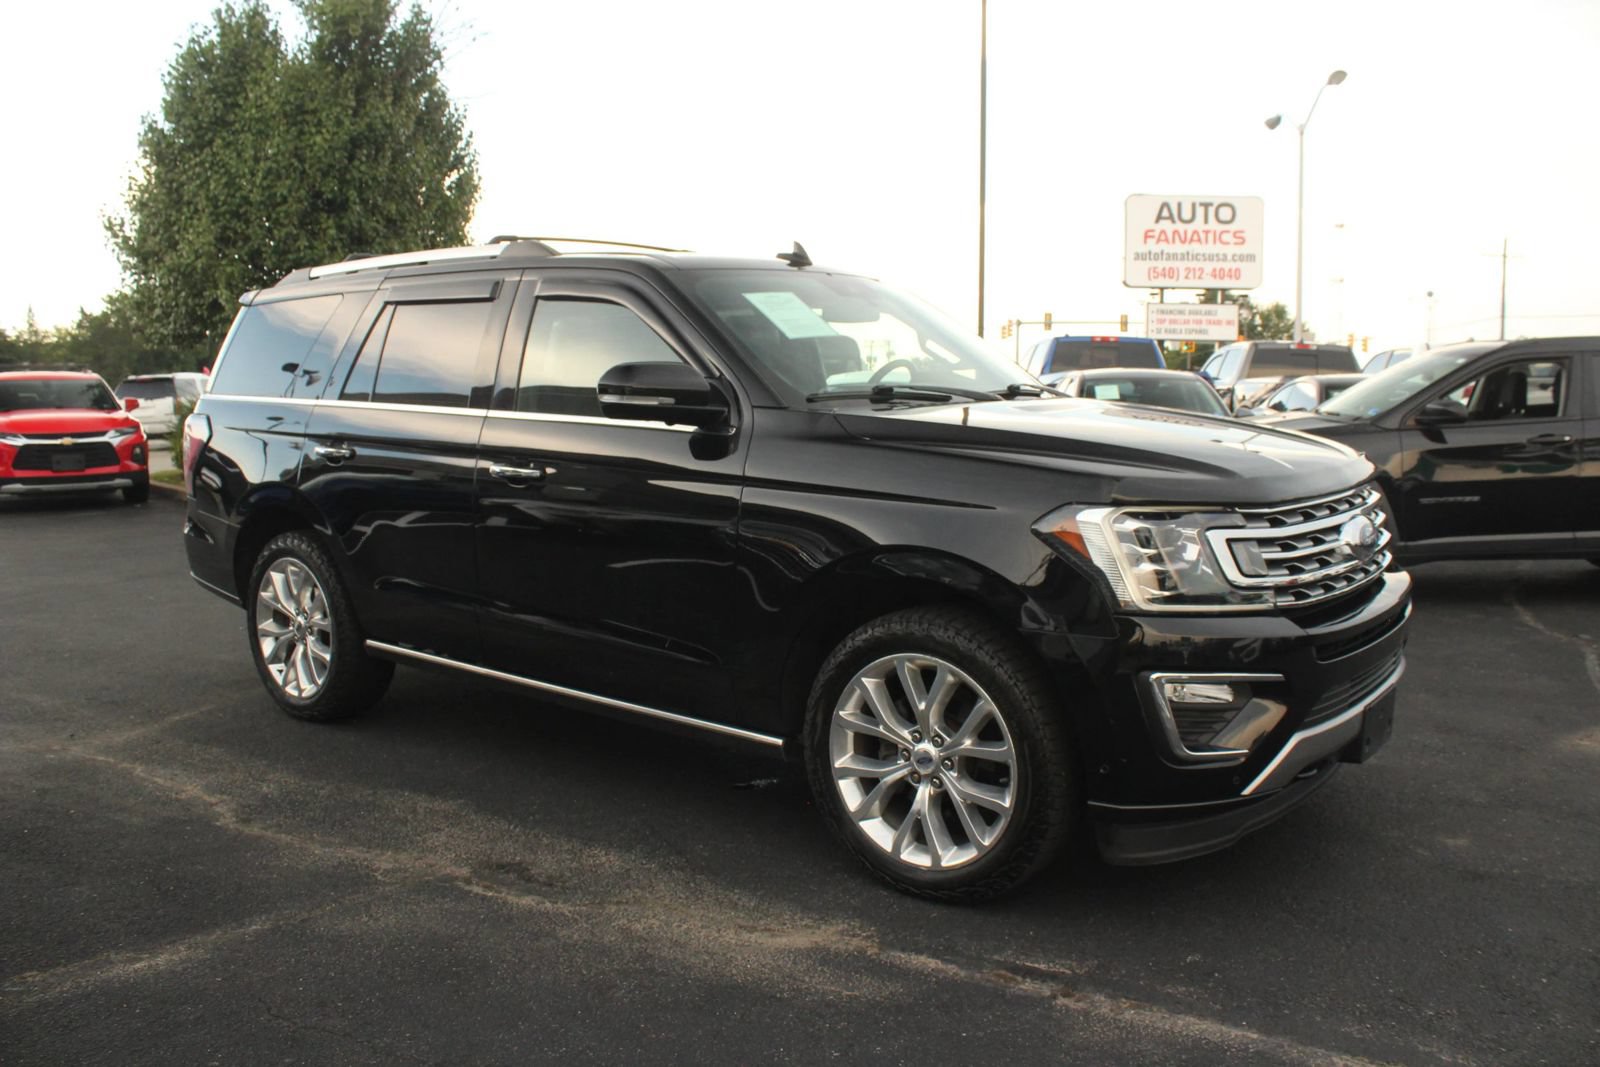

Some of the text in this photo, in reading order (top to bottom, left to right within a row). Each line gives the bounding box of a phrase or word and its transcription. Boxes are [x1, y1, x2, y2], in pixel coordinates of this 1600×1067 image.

[1155, 201, 1236, 224] AUTO
[1143, 229, 1246, 245] FANATICS
[1133, 249, 1256, 262] autofanaticsusa.com
[1147, 266, 1180, 281] (540)
